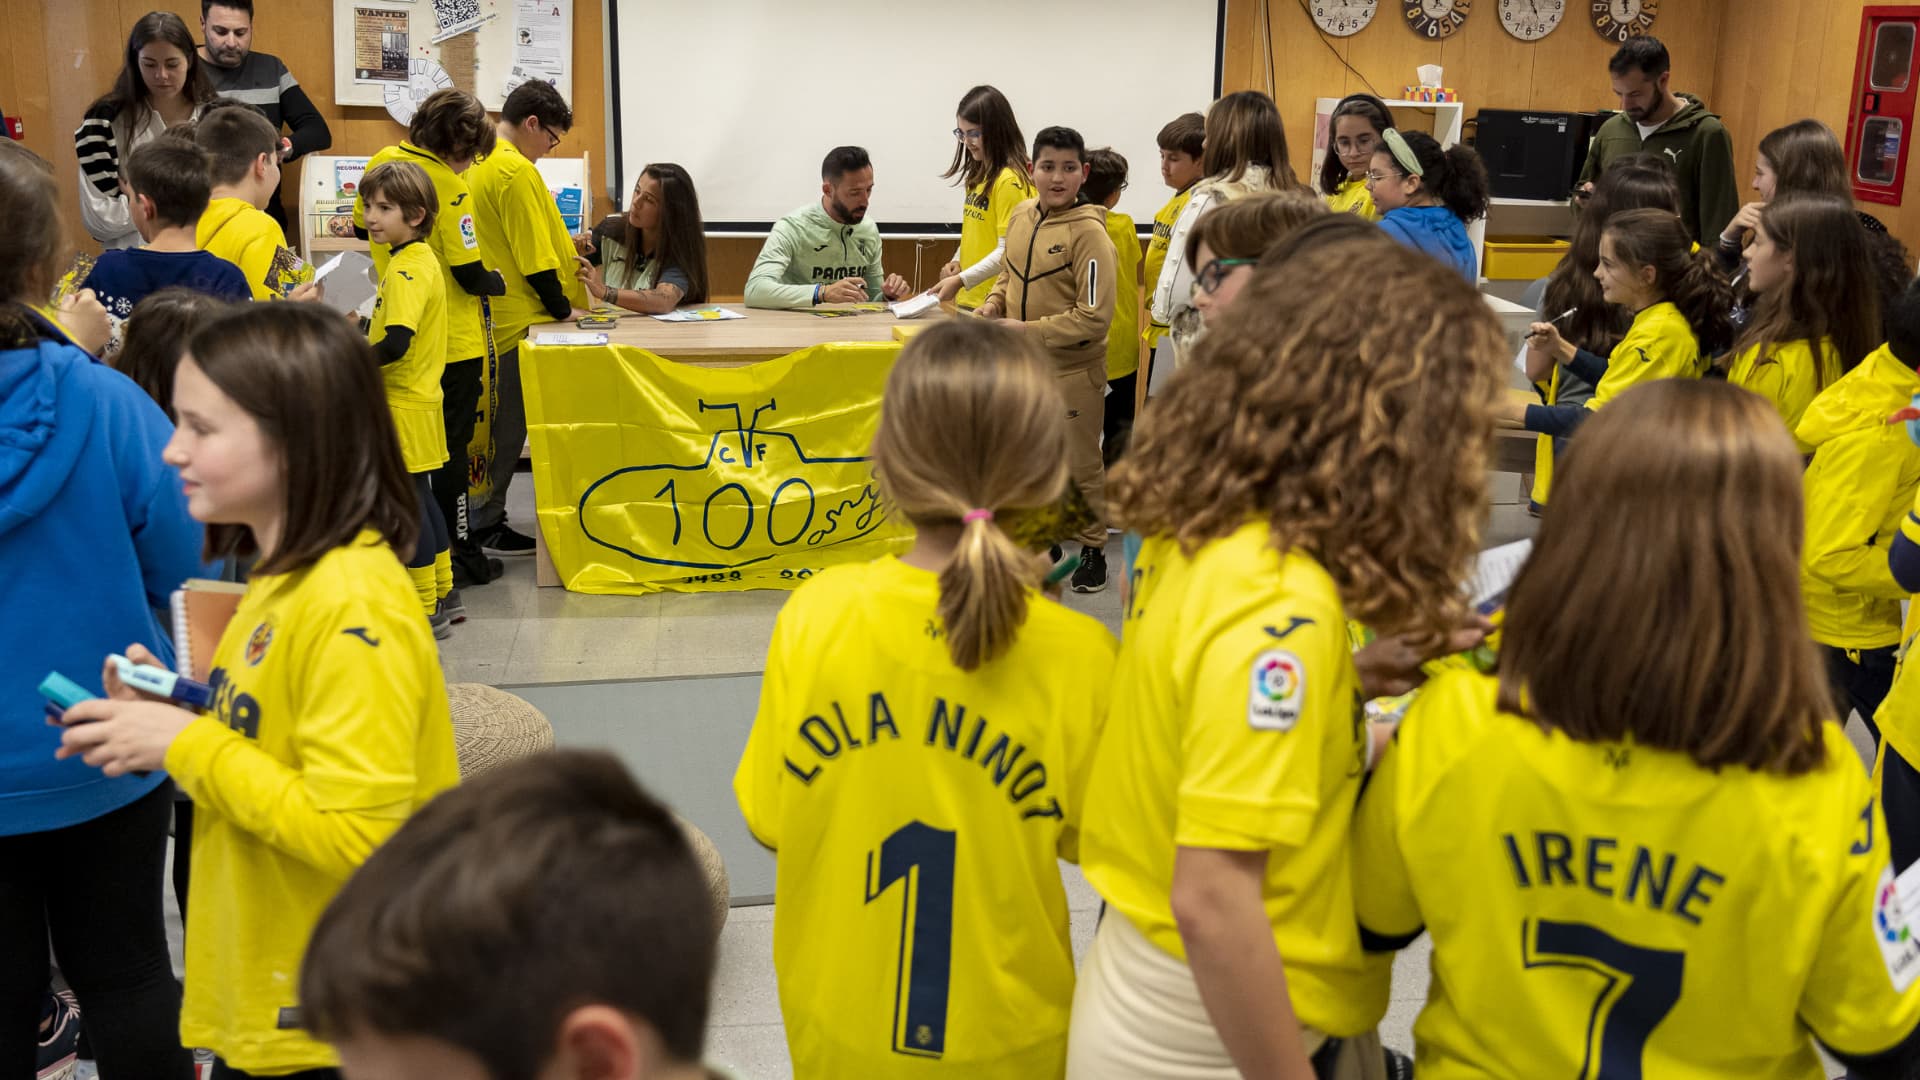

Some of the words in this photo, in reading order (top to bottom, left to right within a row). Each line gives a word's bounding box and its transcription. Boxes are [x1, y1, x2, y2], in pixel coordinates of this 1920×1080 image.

[357, 10, 407, 18] WANTED
[655, 477, 815, 550] 100
[785, 692, 901, 786] LOLA
[925, 697, 1065, 823] NINOT
[1502, 831, 1726, 926] IRENE
[865, 819, 957, 1059] 1
[1522, 916, 1687, 1080] 7
